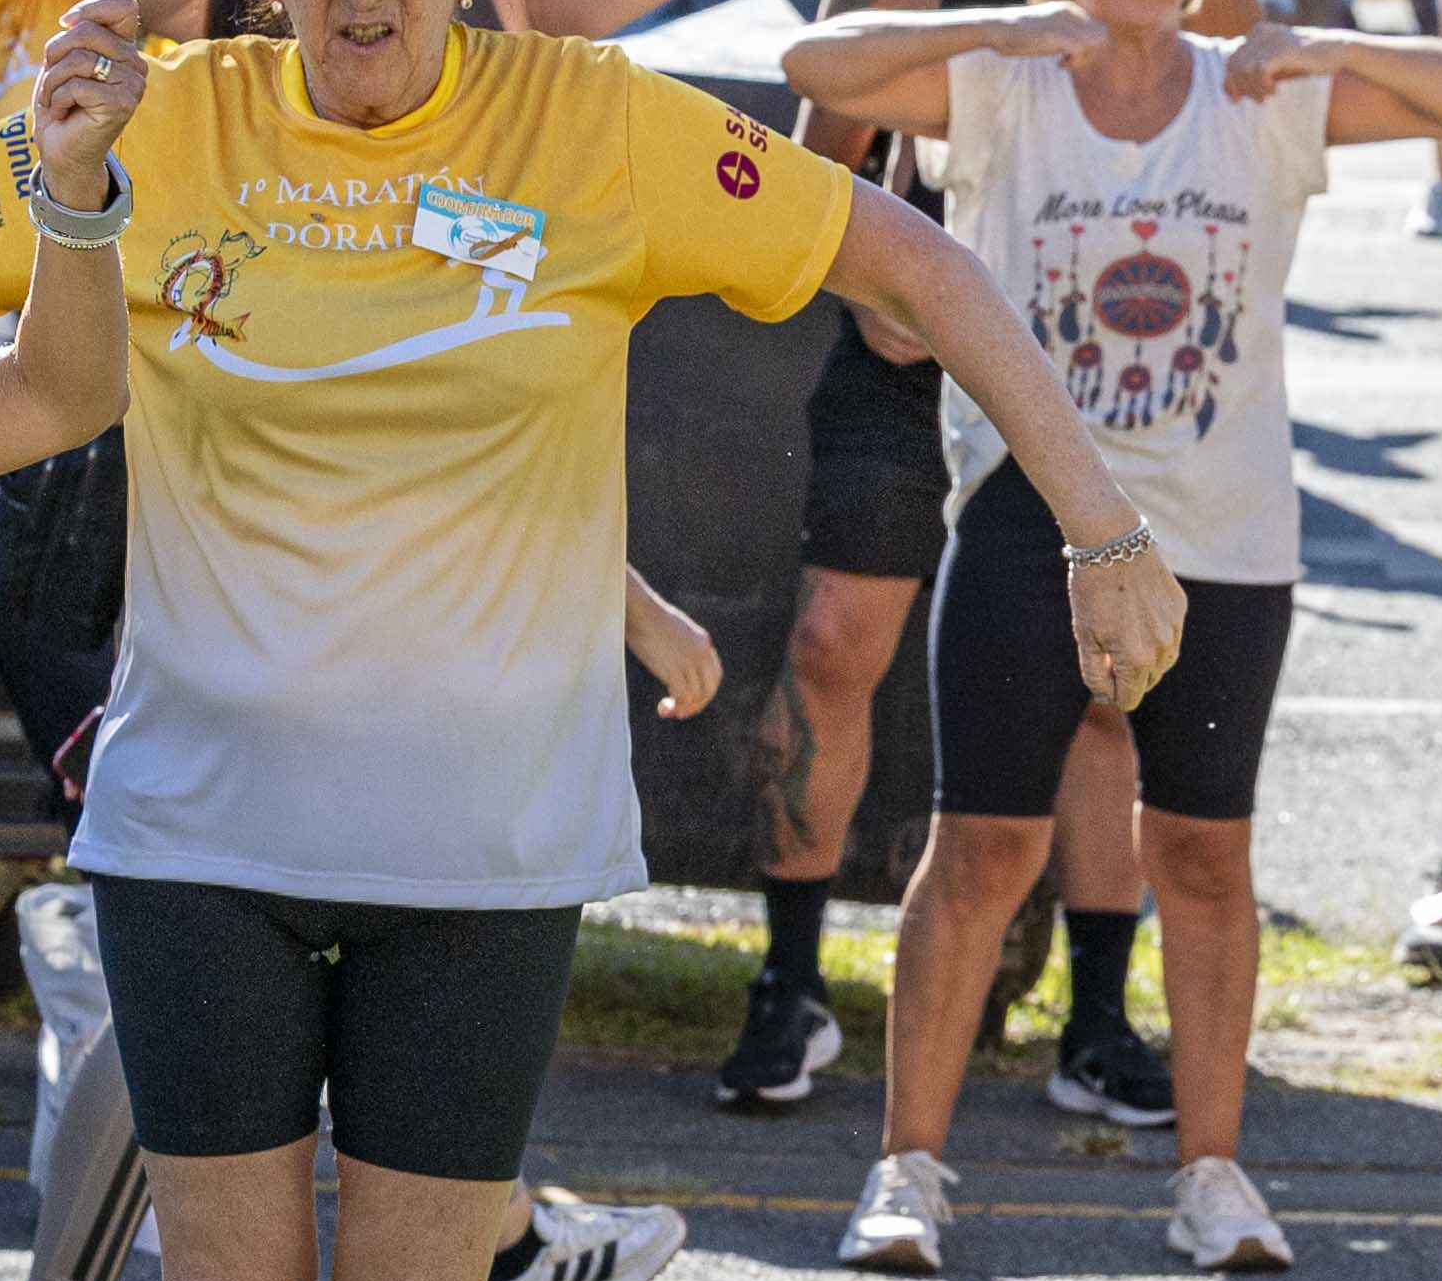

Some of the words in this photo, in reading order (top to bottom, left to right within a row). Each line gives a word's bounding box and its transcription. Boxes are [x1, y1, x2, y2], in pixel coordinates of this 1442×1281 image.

[425, 189, 536, 230] COORDINADOR
[1033, 190, 1105, 226] More
[1110, 194, 1168, 218] Love
